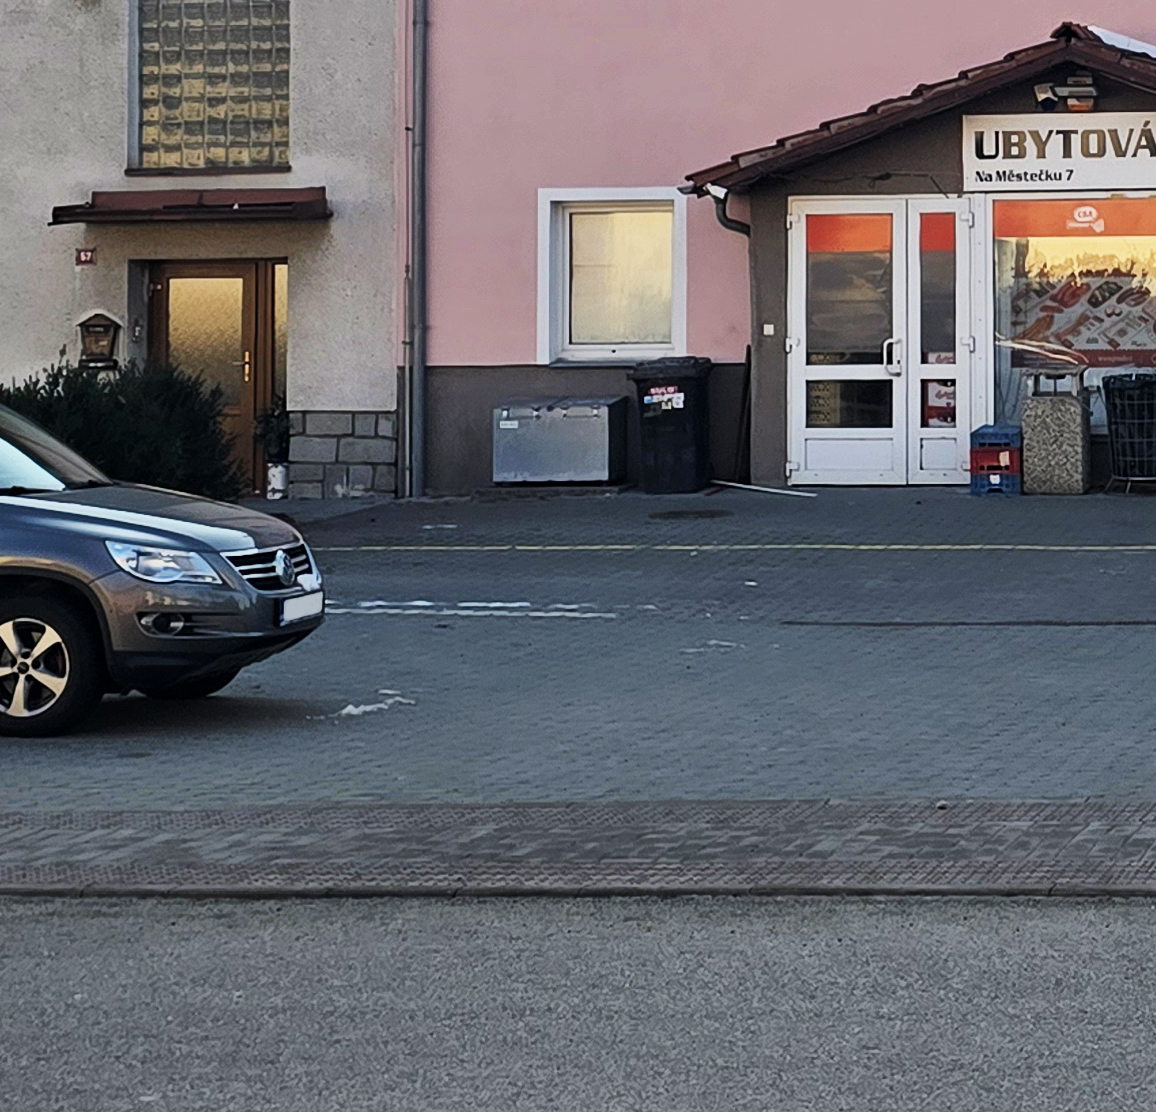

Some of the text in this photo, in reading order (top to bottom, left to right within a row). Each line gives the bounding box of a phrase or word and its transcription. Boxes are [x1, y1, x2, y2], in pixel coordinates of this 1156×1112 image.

[975, 169, 1074, 182] Na Městečku 7
